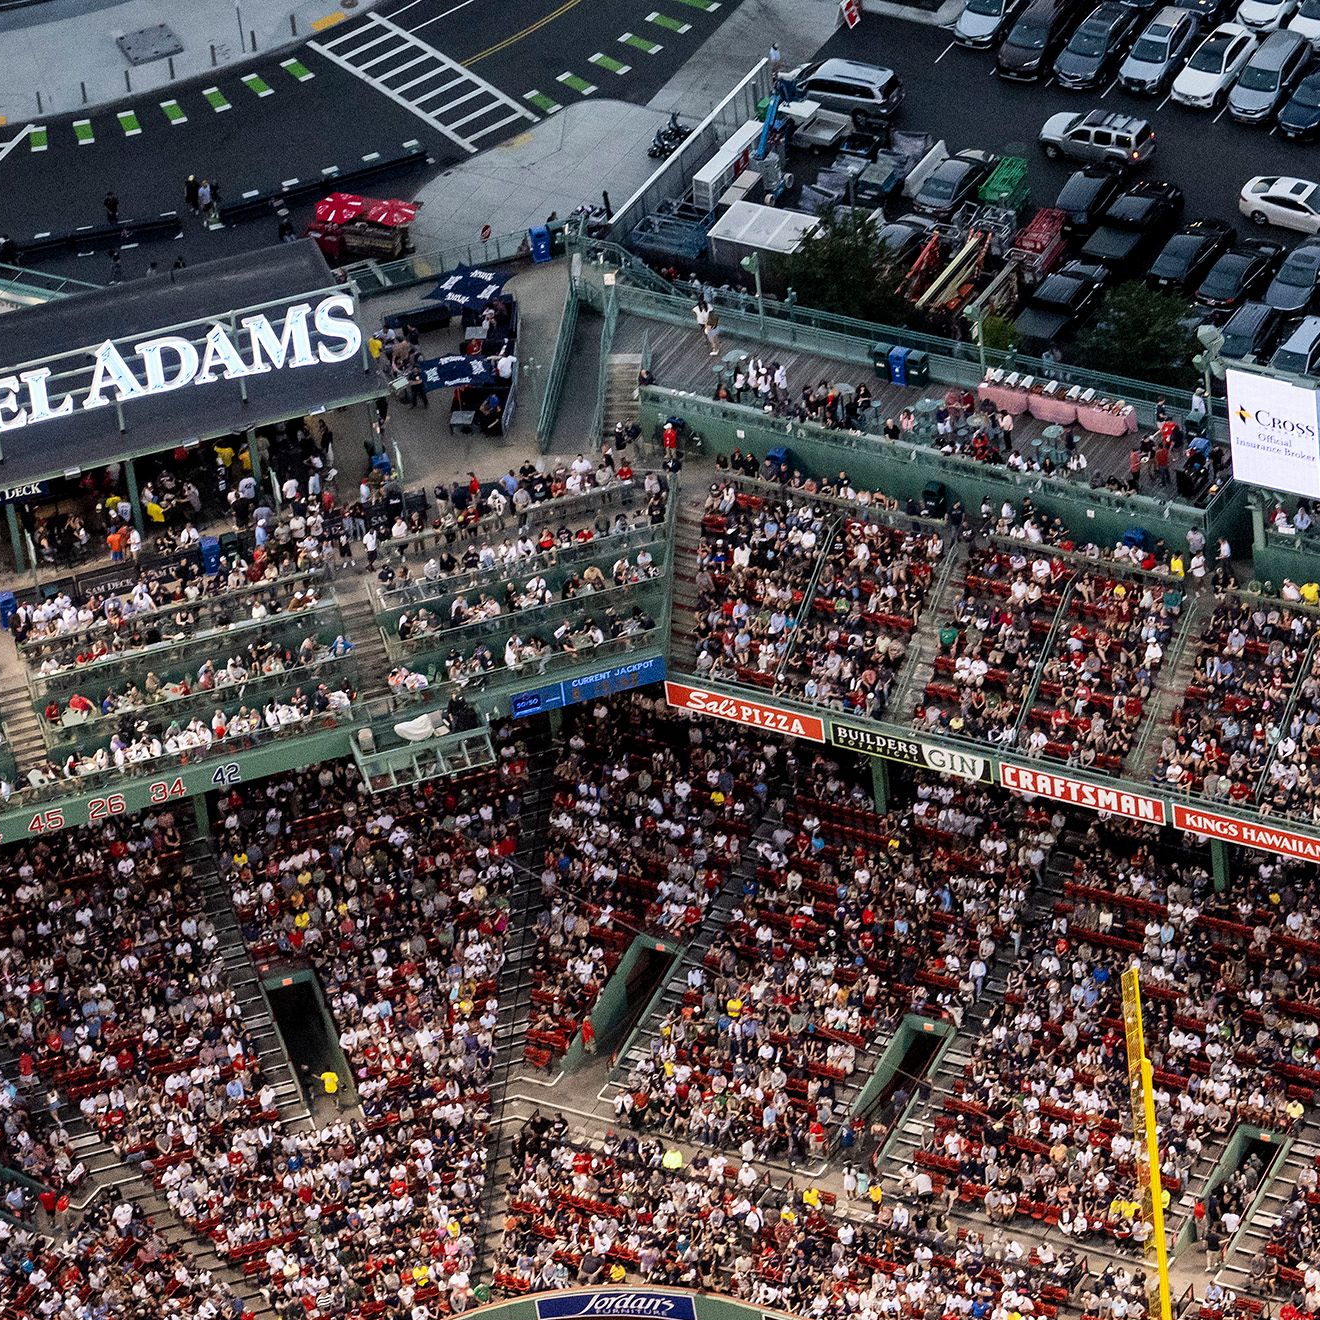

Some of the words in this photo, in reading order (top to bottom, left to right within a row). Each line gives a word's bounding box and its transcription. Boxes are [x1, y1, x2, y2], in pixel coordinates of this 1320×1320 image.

[82, 294, 364, 411] ADAMS
[1236, 437, 1282, 455] Insurance
[1284, 448, 1316, 462] Broker
[1257, 433, 1292, 448] Official
[4, 481, 42, 503] DECK
[571, 670, 611, 688] CURRENT
[614, 659, 654, 677] JACKPOT
[686, 691, 741, 719] Sal's
[740, 706, 806, 736] PIZZA
[837, 727, 918, 755] BUILDERS
[839, 736, 919, 763] BOTANICAL
[928, 749, 977, 778] GIN
[29, 808, 65, 833] 45
[87, 793, 126, 820] 26
[149, 777, 186, 803] 34
[211, 763, 241, 785] 42
[1004, 766, 1155, 821] CRAFTSMAN
[581, 1294, 675, 1314] Jordan's
[595, 1307, 668, 1317] FURNITURE
